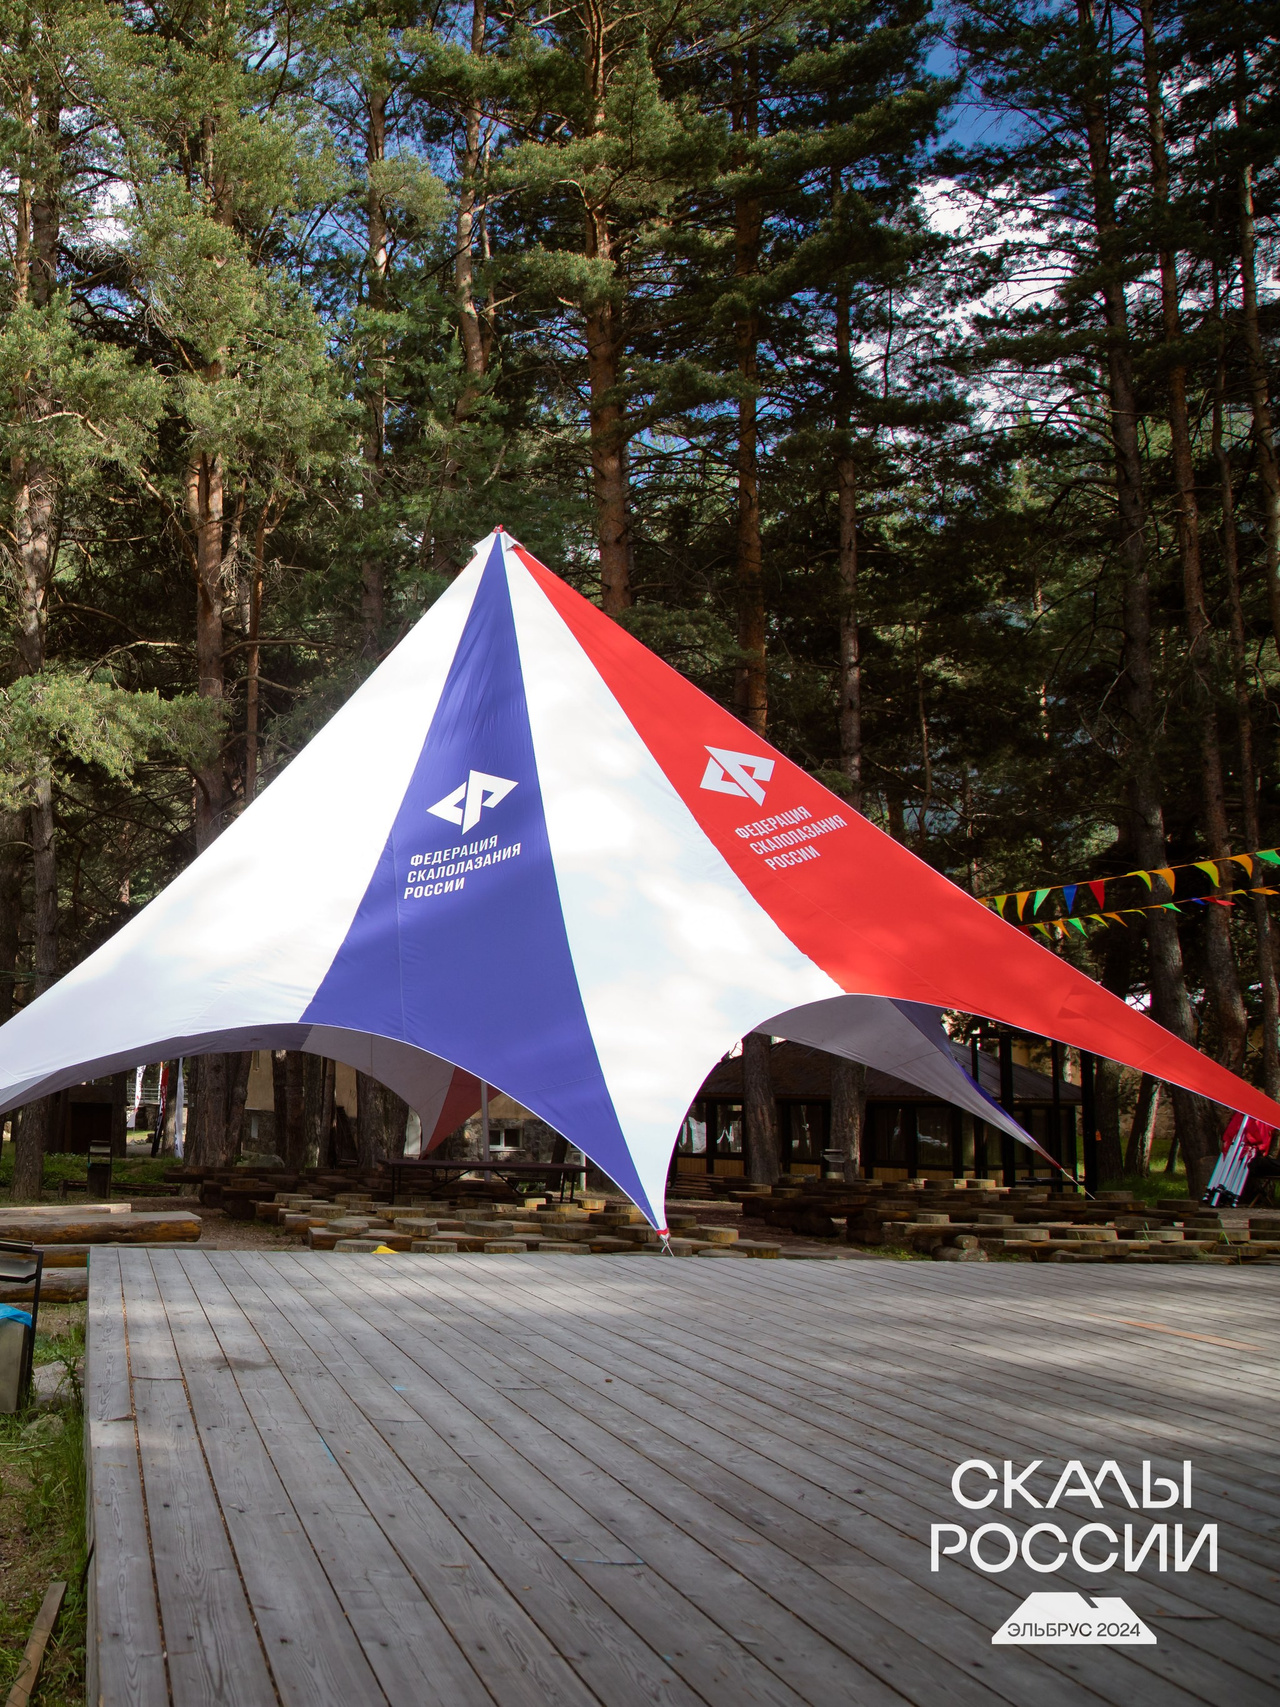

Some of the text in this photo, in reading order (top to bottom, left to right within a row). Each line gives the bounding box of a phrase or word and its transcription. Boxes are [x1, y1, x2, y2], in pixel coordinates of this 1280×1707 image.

[734, 805, 812, 839] ФЕДЕРАЦИЯ
[749, 814, 848, 855] СКАЛОЛАЗАНИЯ
[407, 842, 521, 883] СКАЛОЛАЗАНИЯ
[410, 834, 498, 867] ФЕДЕРАЦИЯ
[764, 845, 821, 870] РОССИИ
[403, 877, 465, 900] РОССИИ
